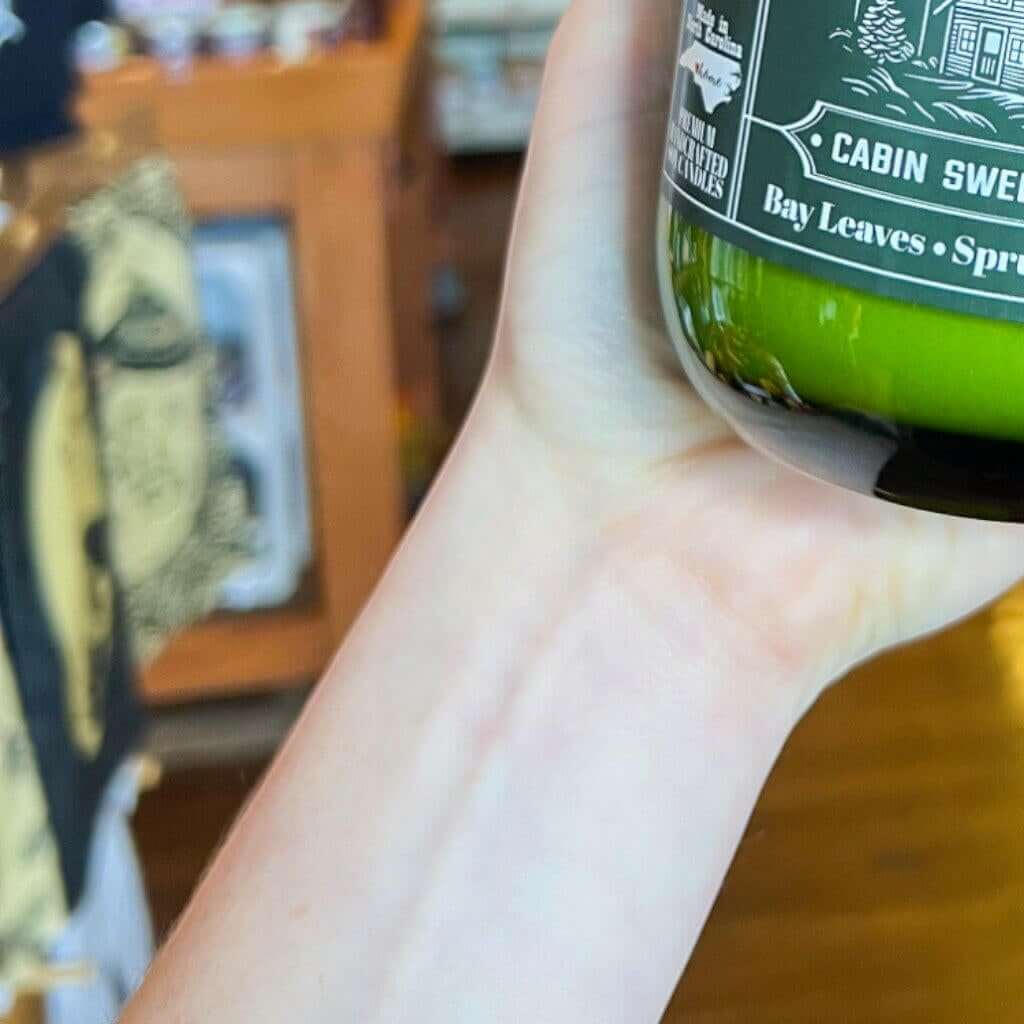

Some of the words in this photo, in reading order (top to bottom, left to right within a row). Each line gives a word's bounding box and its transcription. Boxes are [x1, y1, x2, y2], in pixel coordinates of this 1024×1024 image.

[831, 132, 928, 183] CABIN
[763, 183, 815, 233] Bay
[818, 201, 926, 257] Leaves
